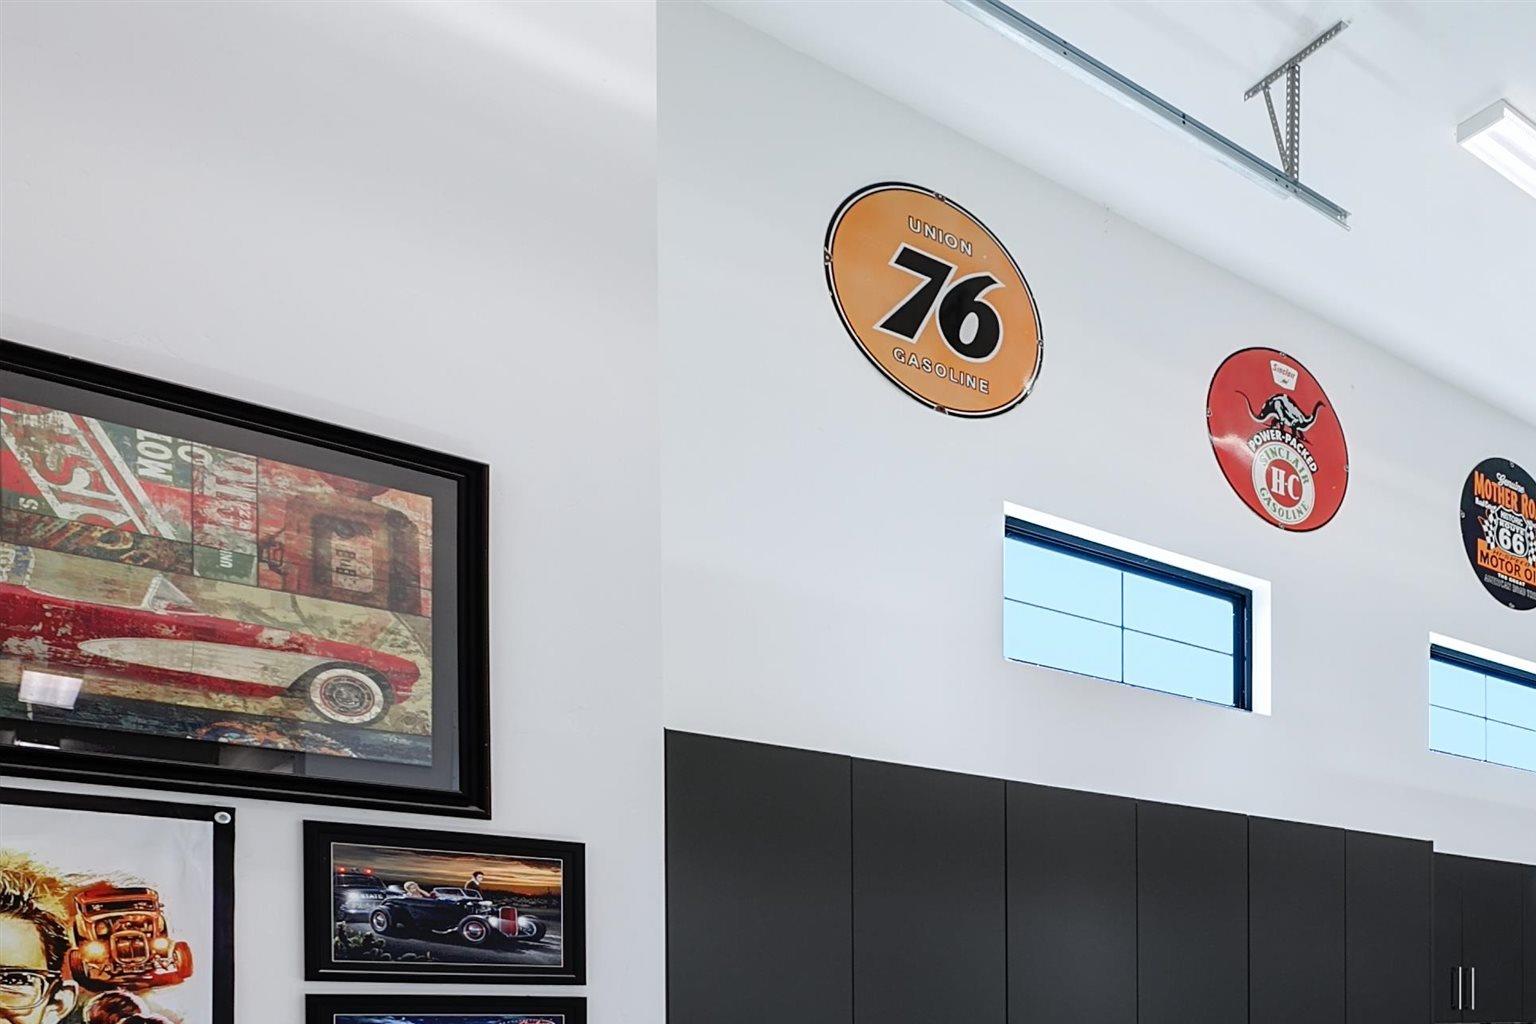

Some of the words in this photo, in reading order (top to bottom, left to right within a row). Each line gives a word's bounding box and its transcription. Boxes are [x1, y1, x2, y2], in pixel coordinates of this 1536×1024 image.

[908, 215, 973, 257] UNION
[873, 242, 1005, 363] 76
[893, 347, 990, 394] GASOLINE
[1248, 429, 1317, 472] POWER-PACKED
[1260, 446, 1309, 484] SINCLAIR
[1260, 487, 1309, 519] GASOLINE
[1475, 470, 1519, 512] MOTHER
[1499, 528, 1525, 555] 66
[1480, 550, 1521, 577] MOTOR
